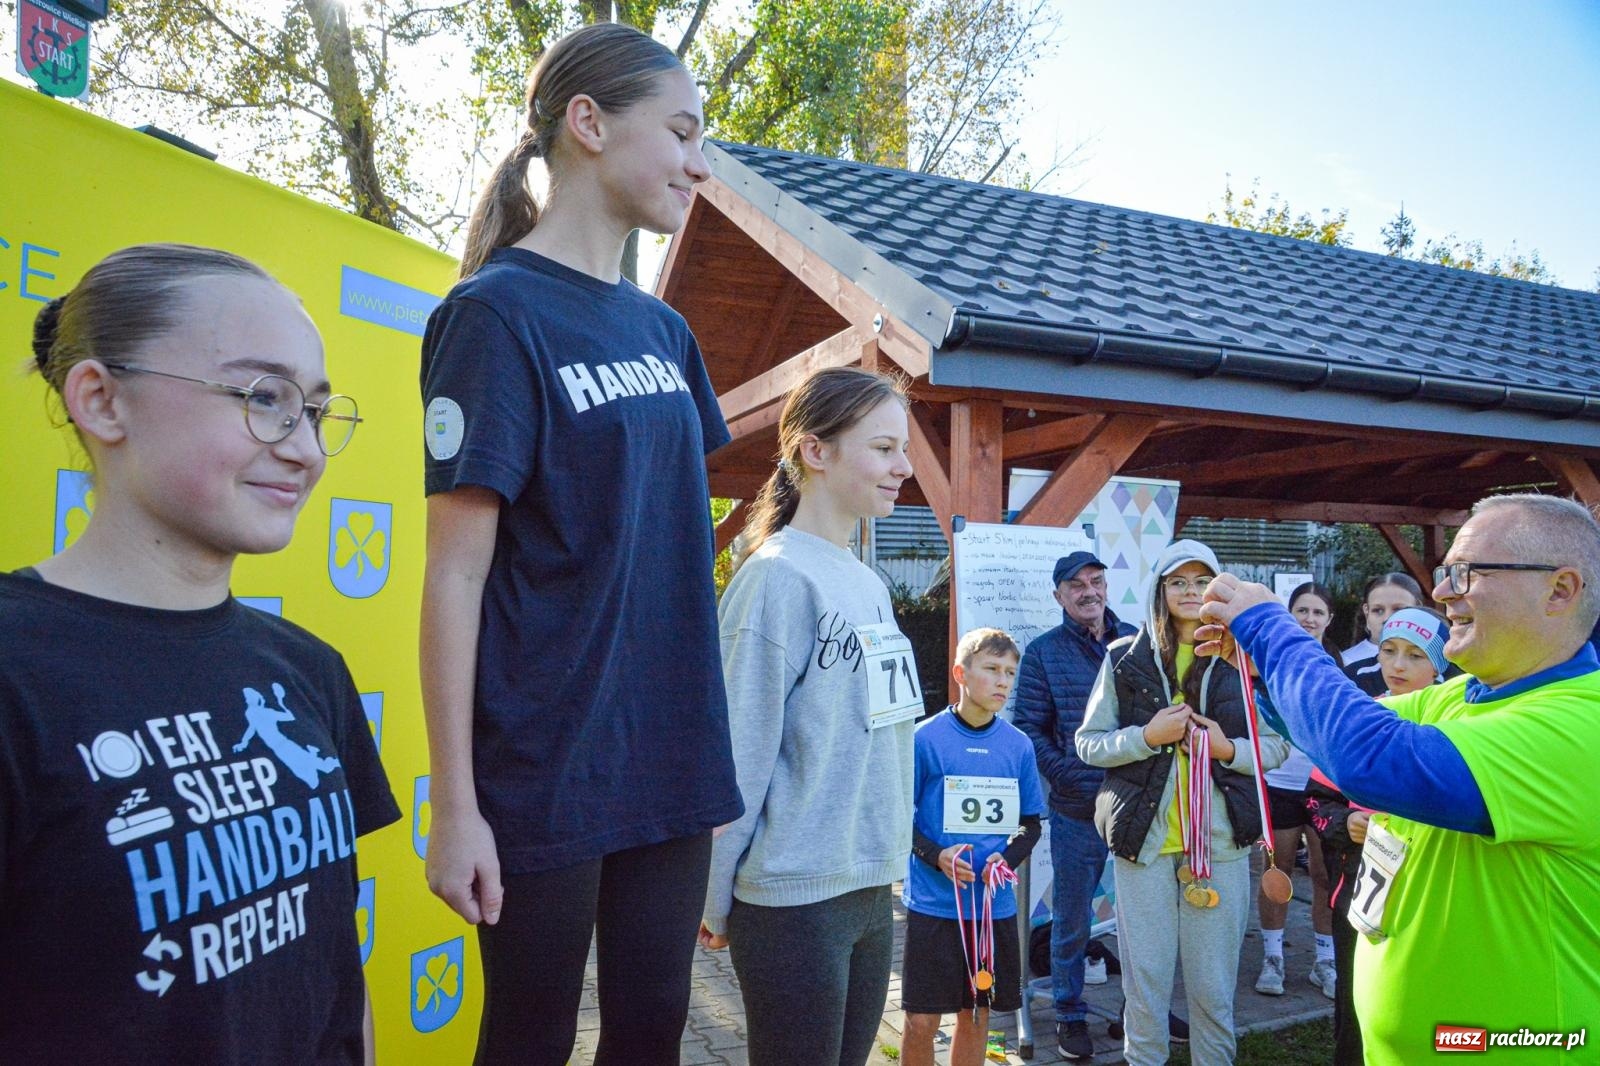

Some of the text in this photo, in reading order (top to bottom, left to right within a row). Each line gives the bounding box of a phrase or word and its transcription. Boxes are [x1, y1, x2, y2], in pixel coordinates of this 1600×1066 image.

[39, 40, 74, 71] START
[880, 656, 917, 704] 71
[145, 711, 222, 769] EAT
[174, 757, 278, 824] SLEEP
[961, 797, 1004, 823] 93
[190, 883, 309, 984] REPEAT
